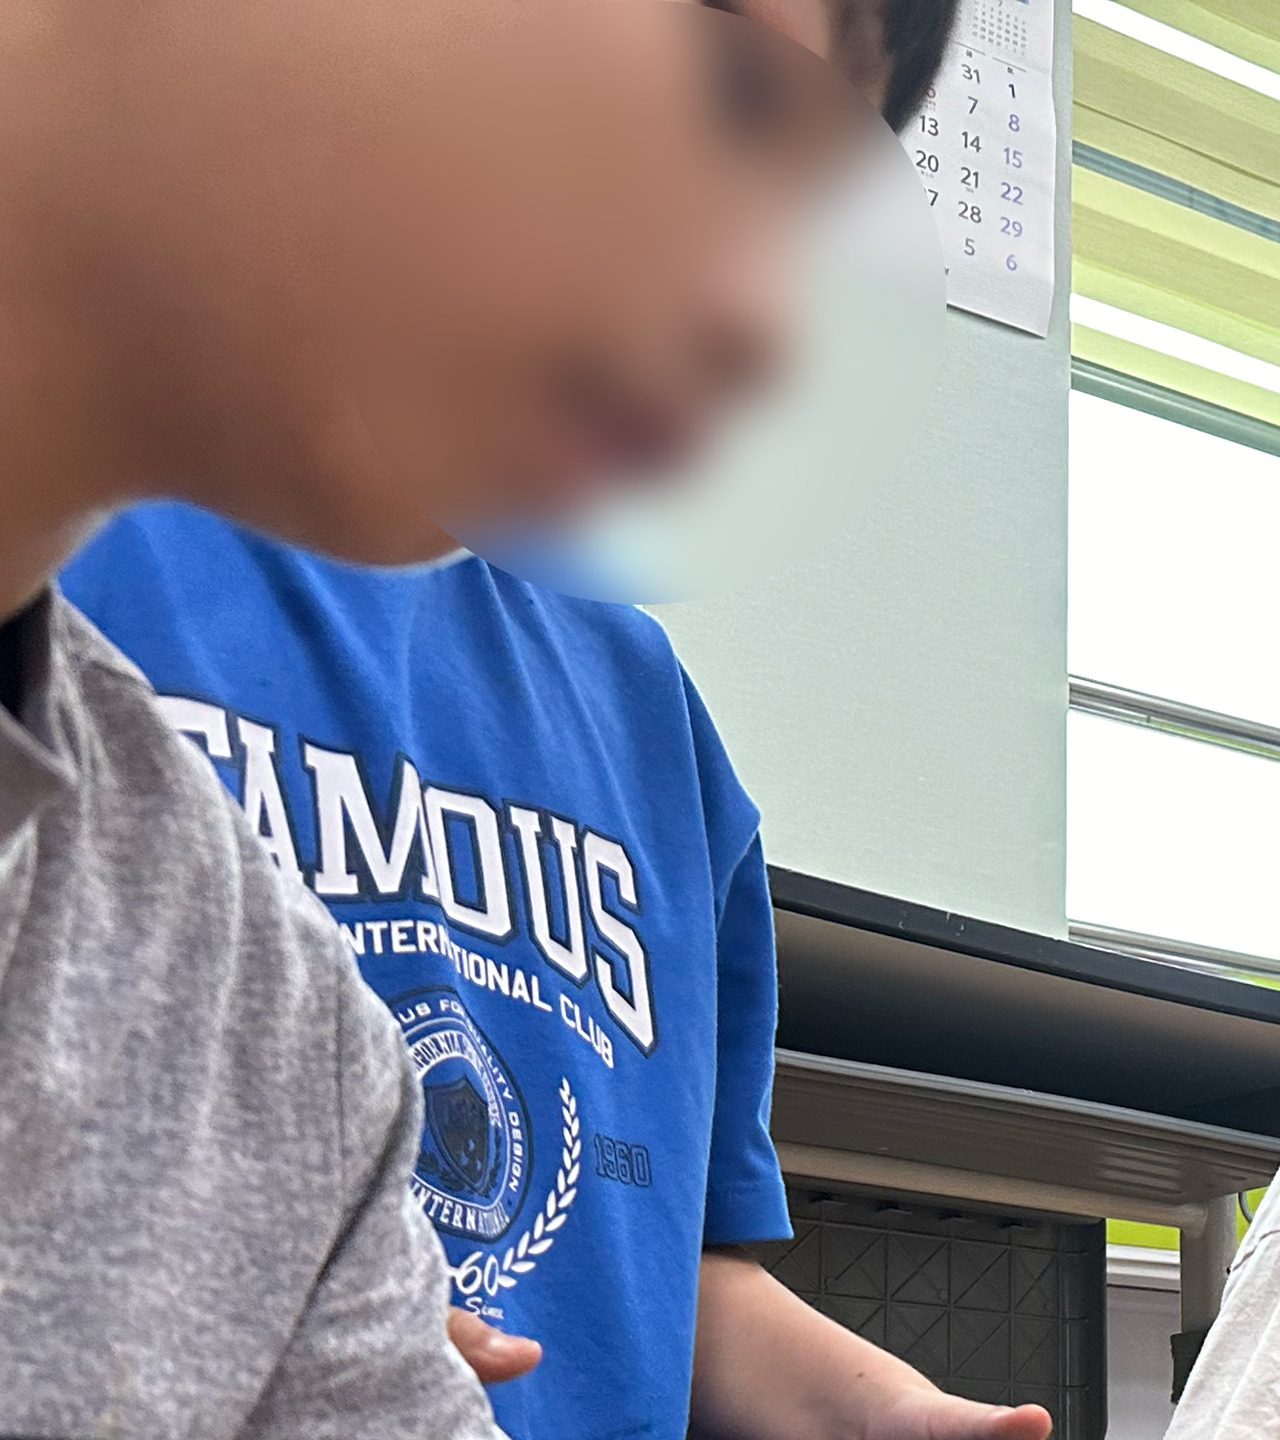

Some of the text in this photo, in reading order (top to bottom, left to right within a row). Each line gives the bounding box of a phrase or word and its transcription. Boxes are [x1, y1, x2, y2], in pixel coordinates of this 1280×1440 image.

[962, 64, 1016, 98] 31 1
[968, 96, 978, 114] 7
[1008, 114, 1020, 132] 8
[920, 115, 1022, 168] 13 14 15
[916, 150, 1023, 205] 20 21 22
[958, 201, 982, 223] 28
[1000, 216, 1023, 238] 29
[964, 237, 1018, 271] 5 6
[558, 993, 614, 1069] CLUB
